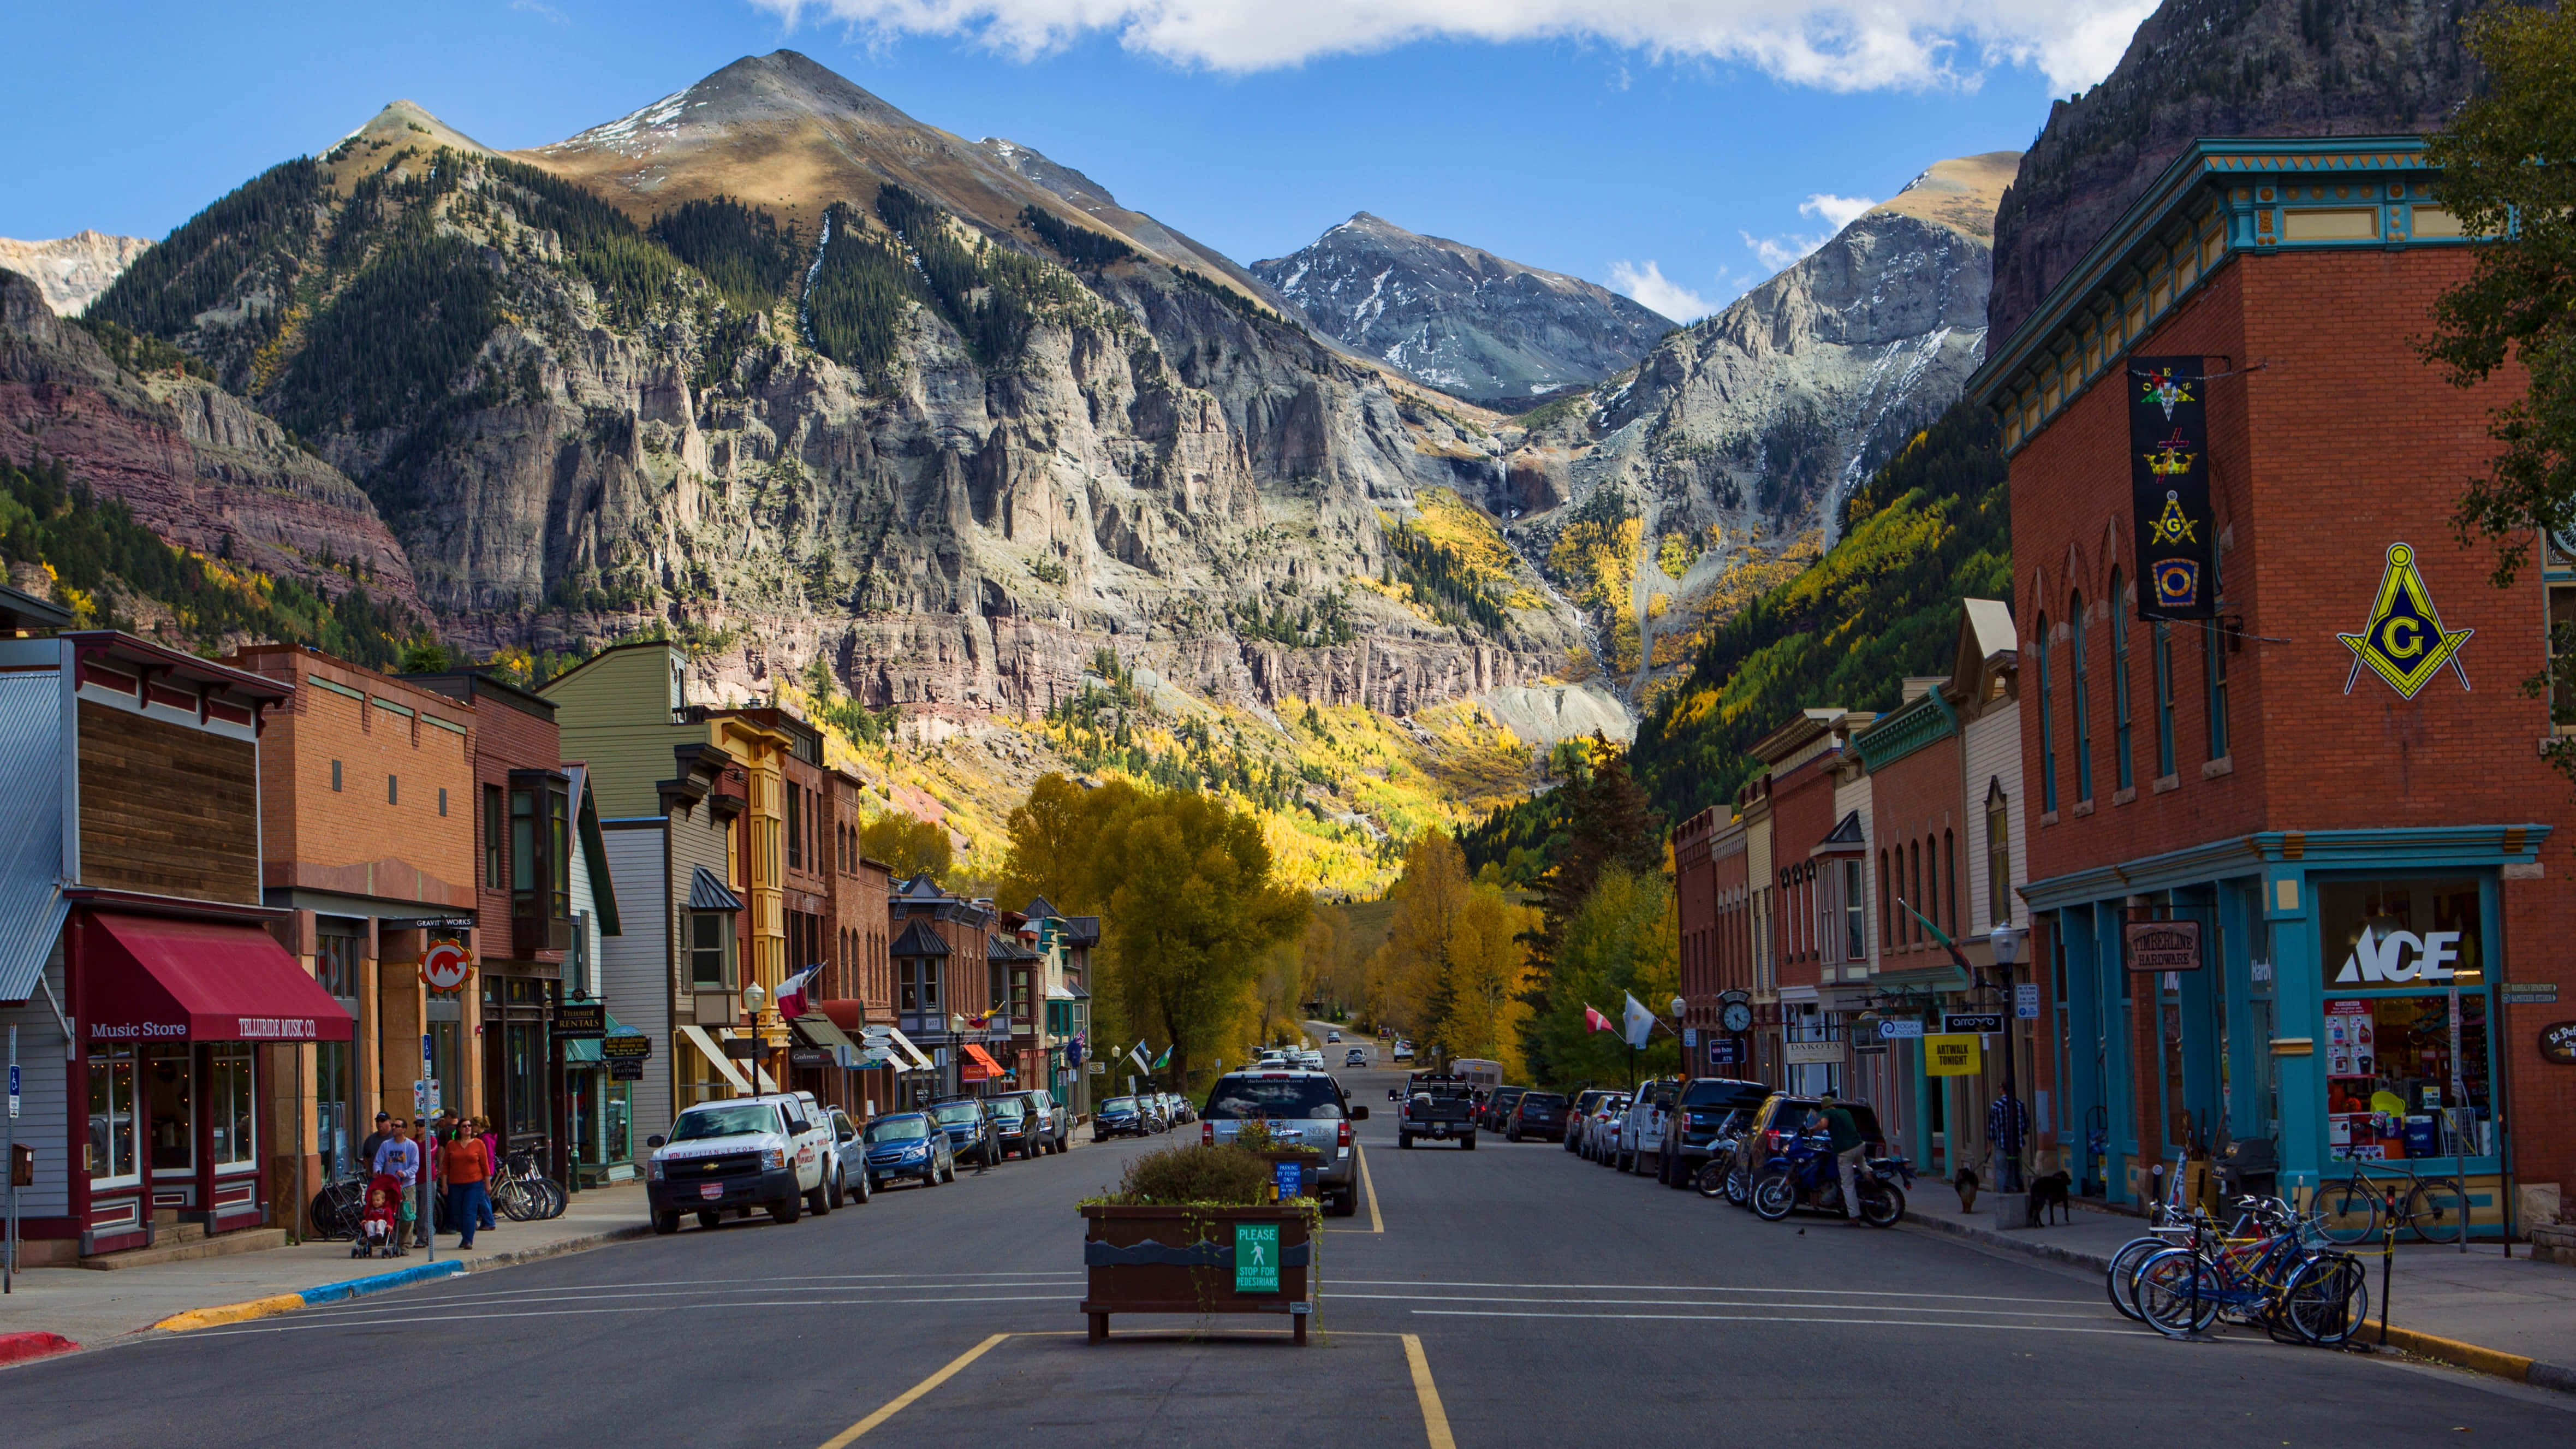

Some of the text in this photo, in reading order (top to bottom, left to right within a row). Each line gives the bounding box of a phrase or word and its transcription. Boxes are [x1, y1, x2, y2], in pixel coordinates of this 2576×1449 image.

[2143, 367, 2192, 391] O E S
[2166, 517, 2181, 532] G
[2382, 615, 2424, 659] G
[2133, 930, 2193, 951] TIMBERLINE
[2335, 924, 2460, 982] ACE
[2138, 953, 2190, 966] HARDWARE
[238, 1018, 317, 1037] TELLURIDE MUSIC CO.
[558, 1019, 599, 1027] RENTALS
[91, 1022, 187, 1037] Music Store
[1936, 1044, 1968, 1054] ARTWALK
[793, 1052, 820, 1060] Cashmere
[1938, 1055, 1968, 1065] TONIGHT
[668, 1151, 681, 1160] MTN
[1239, 1229, 1276, 1240] PLEASE
[1240, 1267, 1275, 1276] STOP FOR
[1236, 1277, 1278, 1287] PEDESTRIANS
